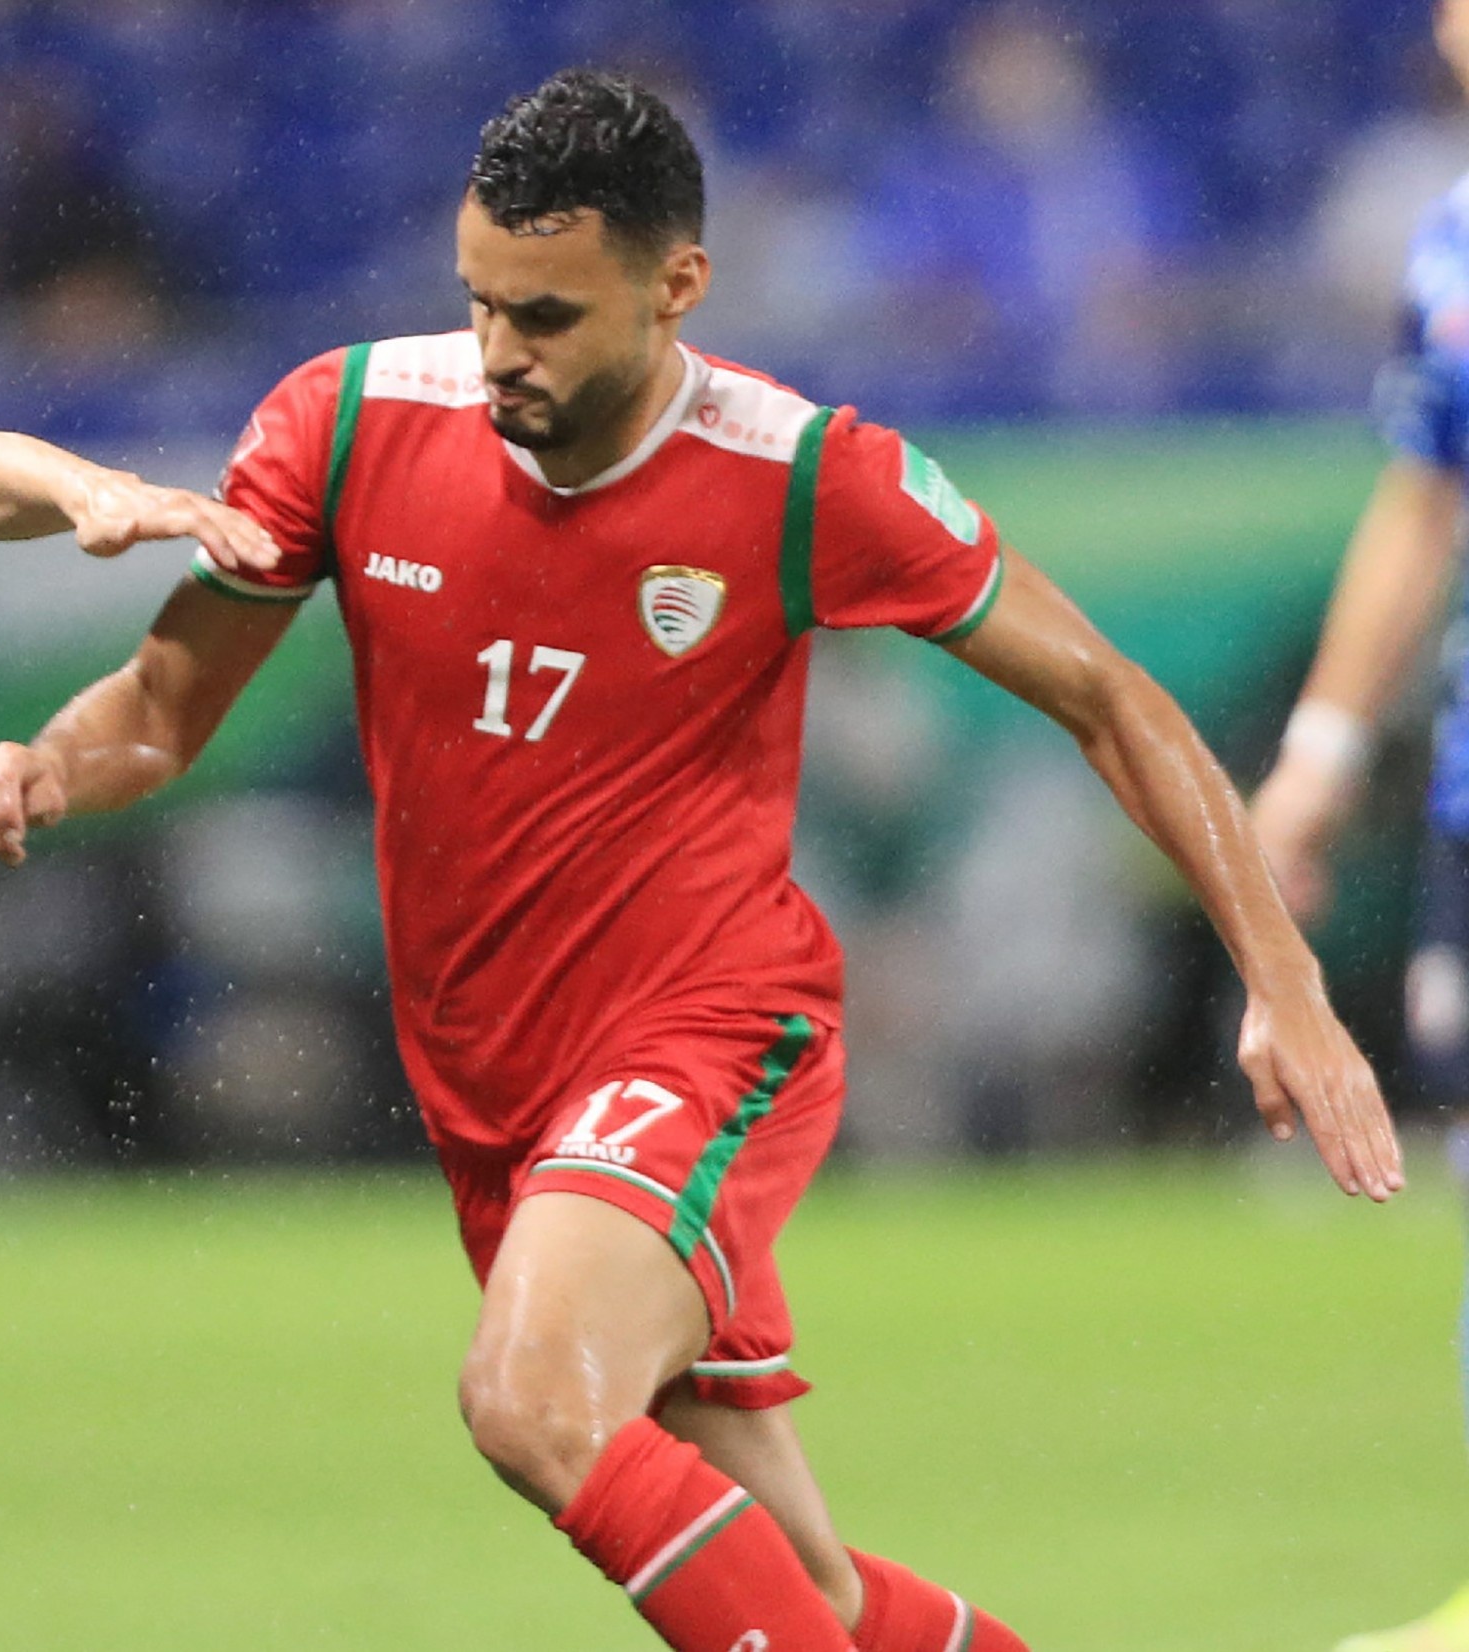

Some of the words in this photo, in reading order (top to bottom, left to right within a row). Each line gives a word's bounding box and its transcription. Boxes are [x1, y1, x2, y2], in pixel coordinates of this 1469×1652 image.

[364, 552, 443, 593] JAKO
[473, 639, 587, 741] 17
[561, 1078, 684, 1145] 17
